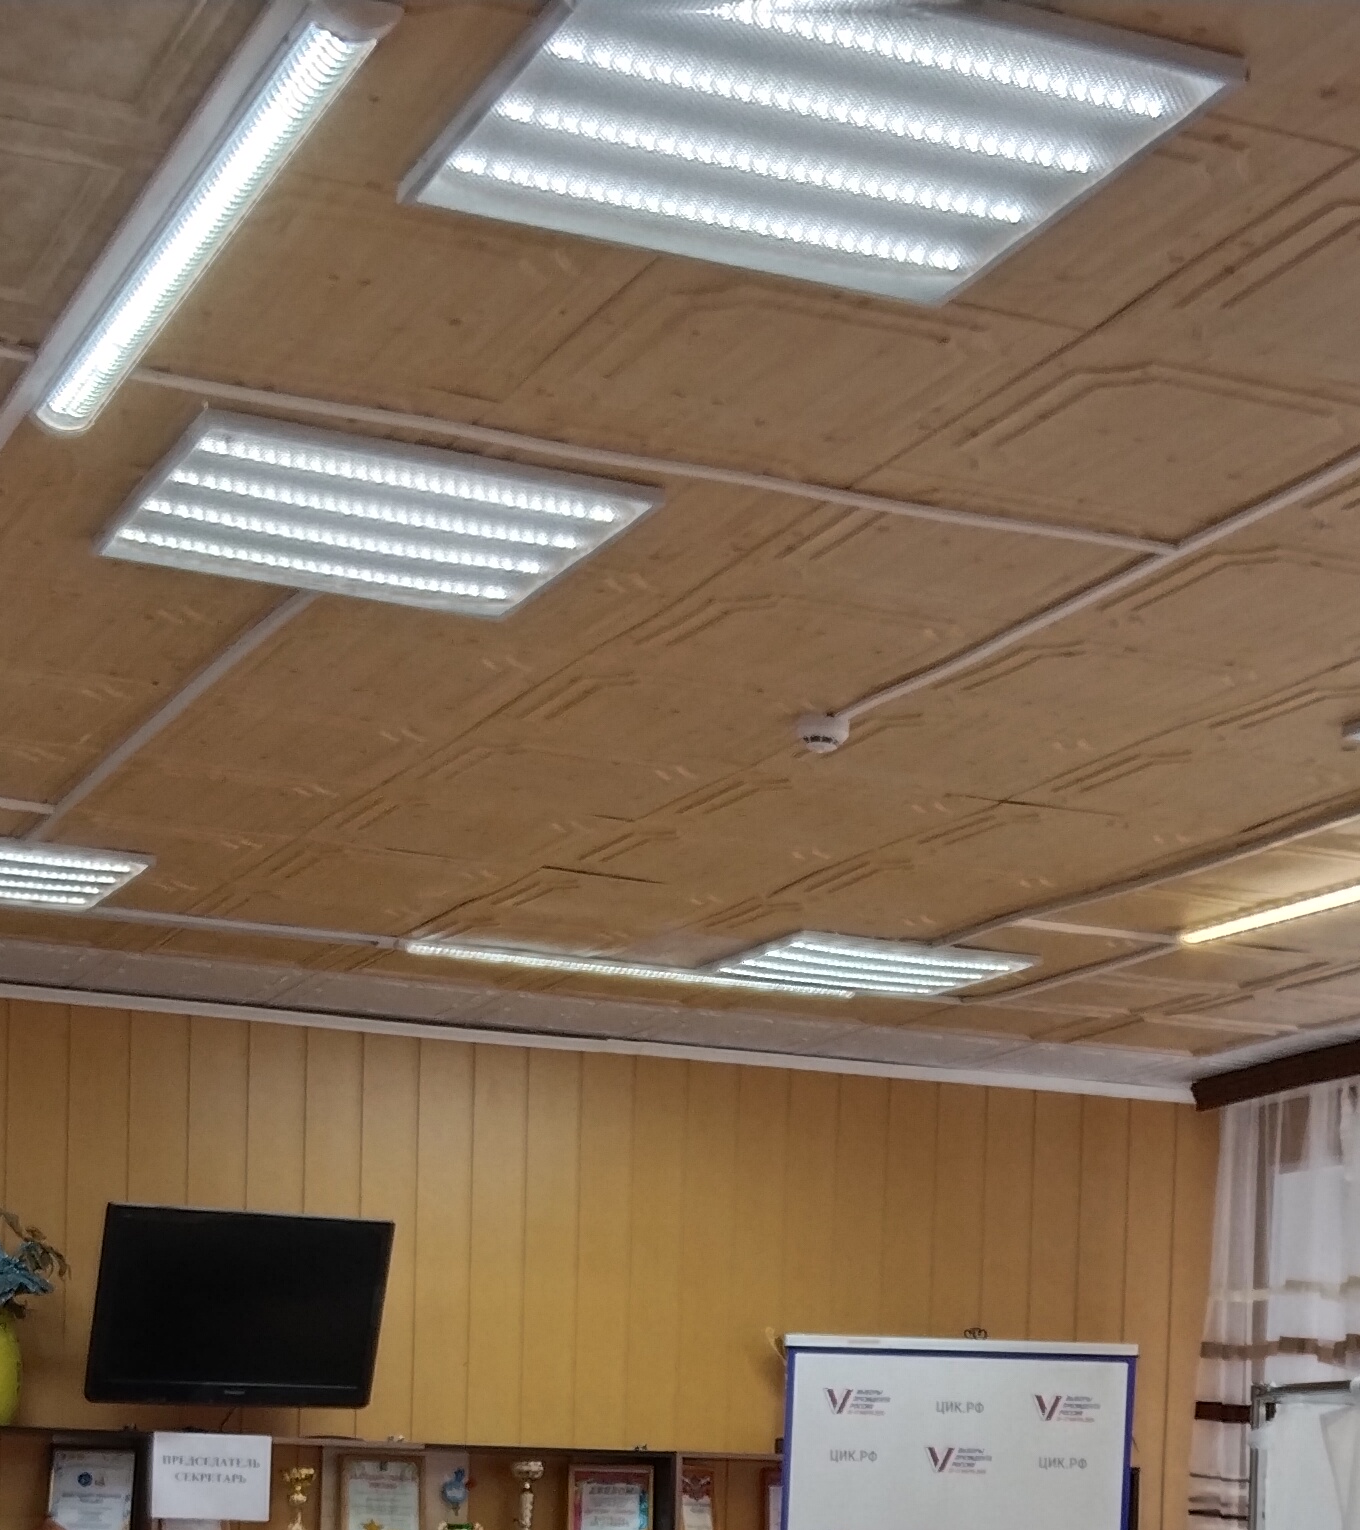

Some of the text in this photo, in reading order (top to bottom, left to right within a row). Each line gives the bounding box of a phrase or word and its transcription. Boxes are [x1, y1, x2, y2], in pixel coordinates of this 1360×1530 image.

[936, 1400, 985, 1415] ЦИК.РФ
[162, 1455, 261, 1469] ПРЕДСЕДАТЕЛЬ
[830, 1449, 878, 1464] ЦИК.РФ
[1039, 1456, 1088, 1471] ЦИК.РФ
[174, 1472, 247, 1484] СЕКРЕТАРЬ
